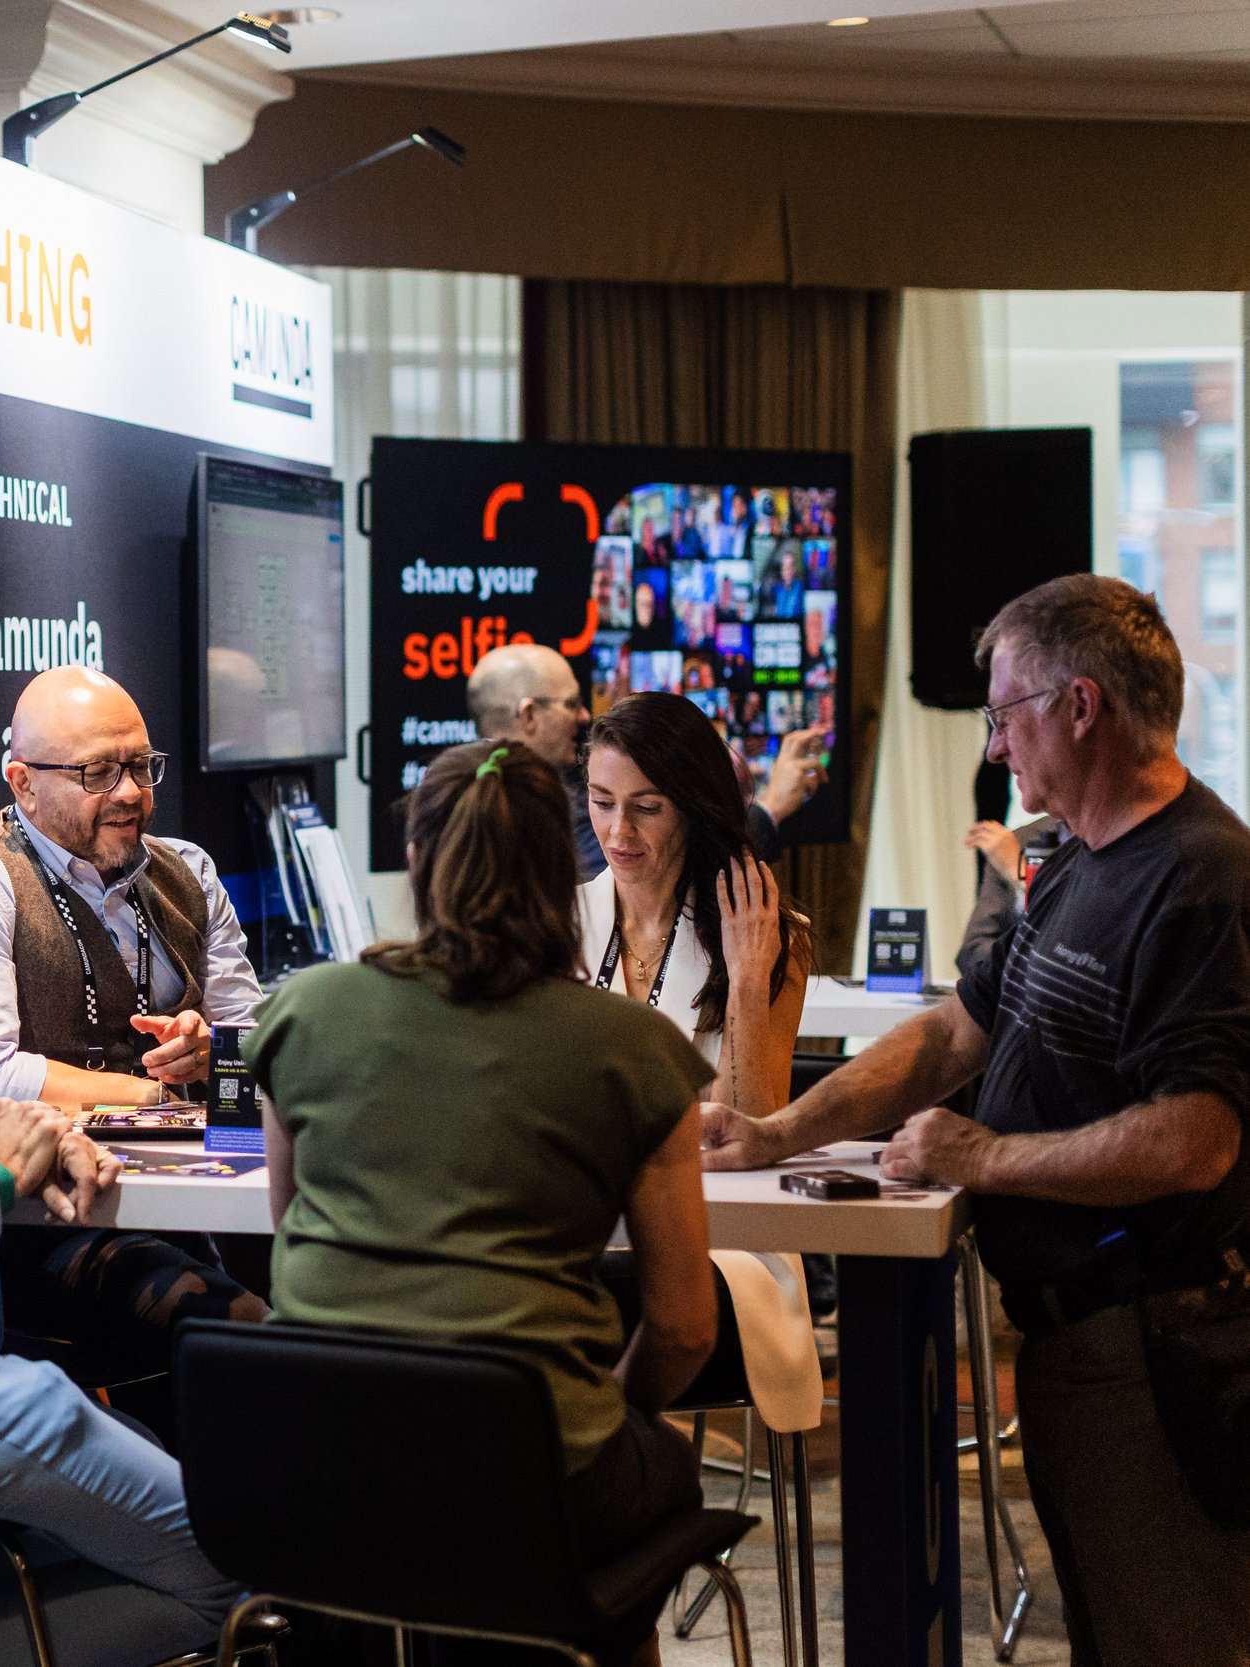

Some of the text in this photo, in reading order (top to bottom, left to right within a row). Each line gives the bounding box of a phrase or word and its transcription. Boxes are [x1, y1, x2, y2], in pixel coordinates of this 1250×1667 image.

[230, 294, 313, 392] CAMUNDA
[401, 557, 538, 601] share your
[403, 615, 535, 679] selfi
[401, 716, 477, 745] #camu
[76, 938, 91, 975] CAMUNDACON
[139, 947, 147, 985] CAMUNDACON
